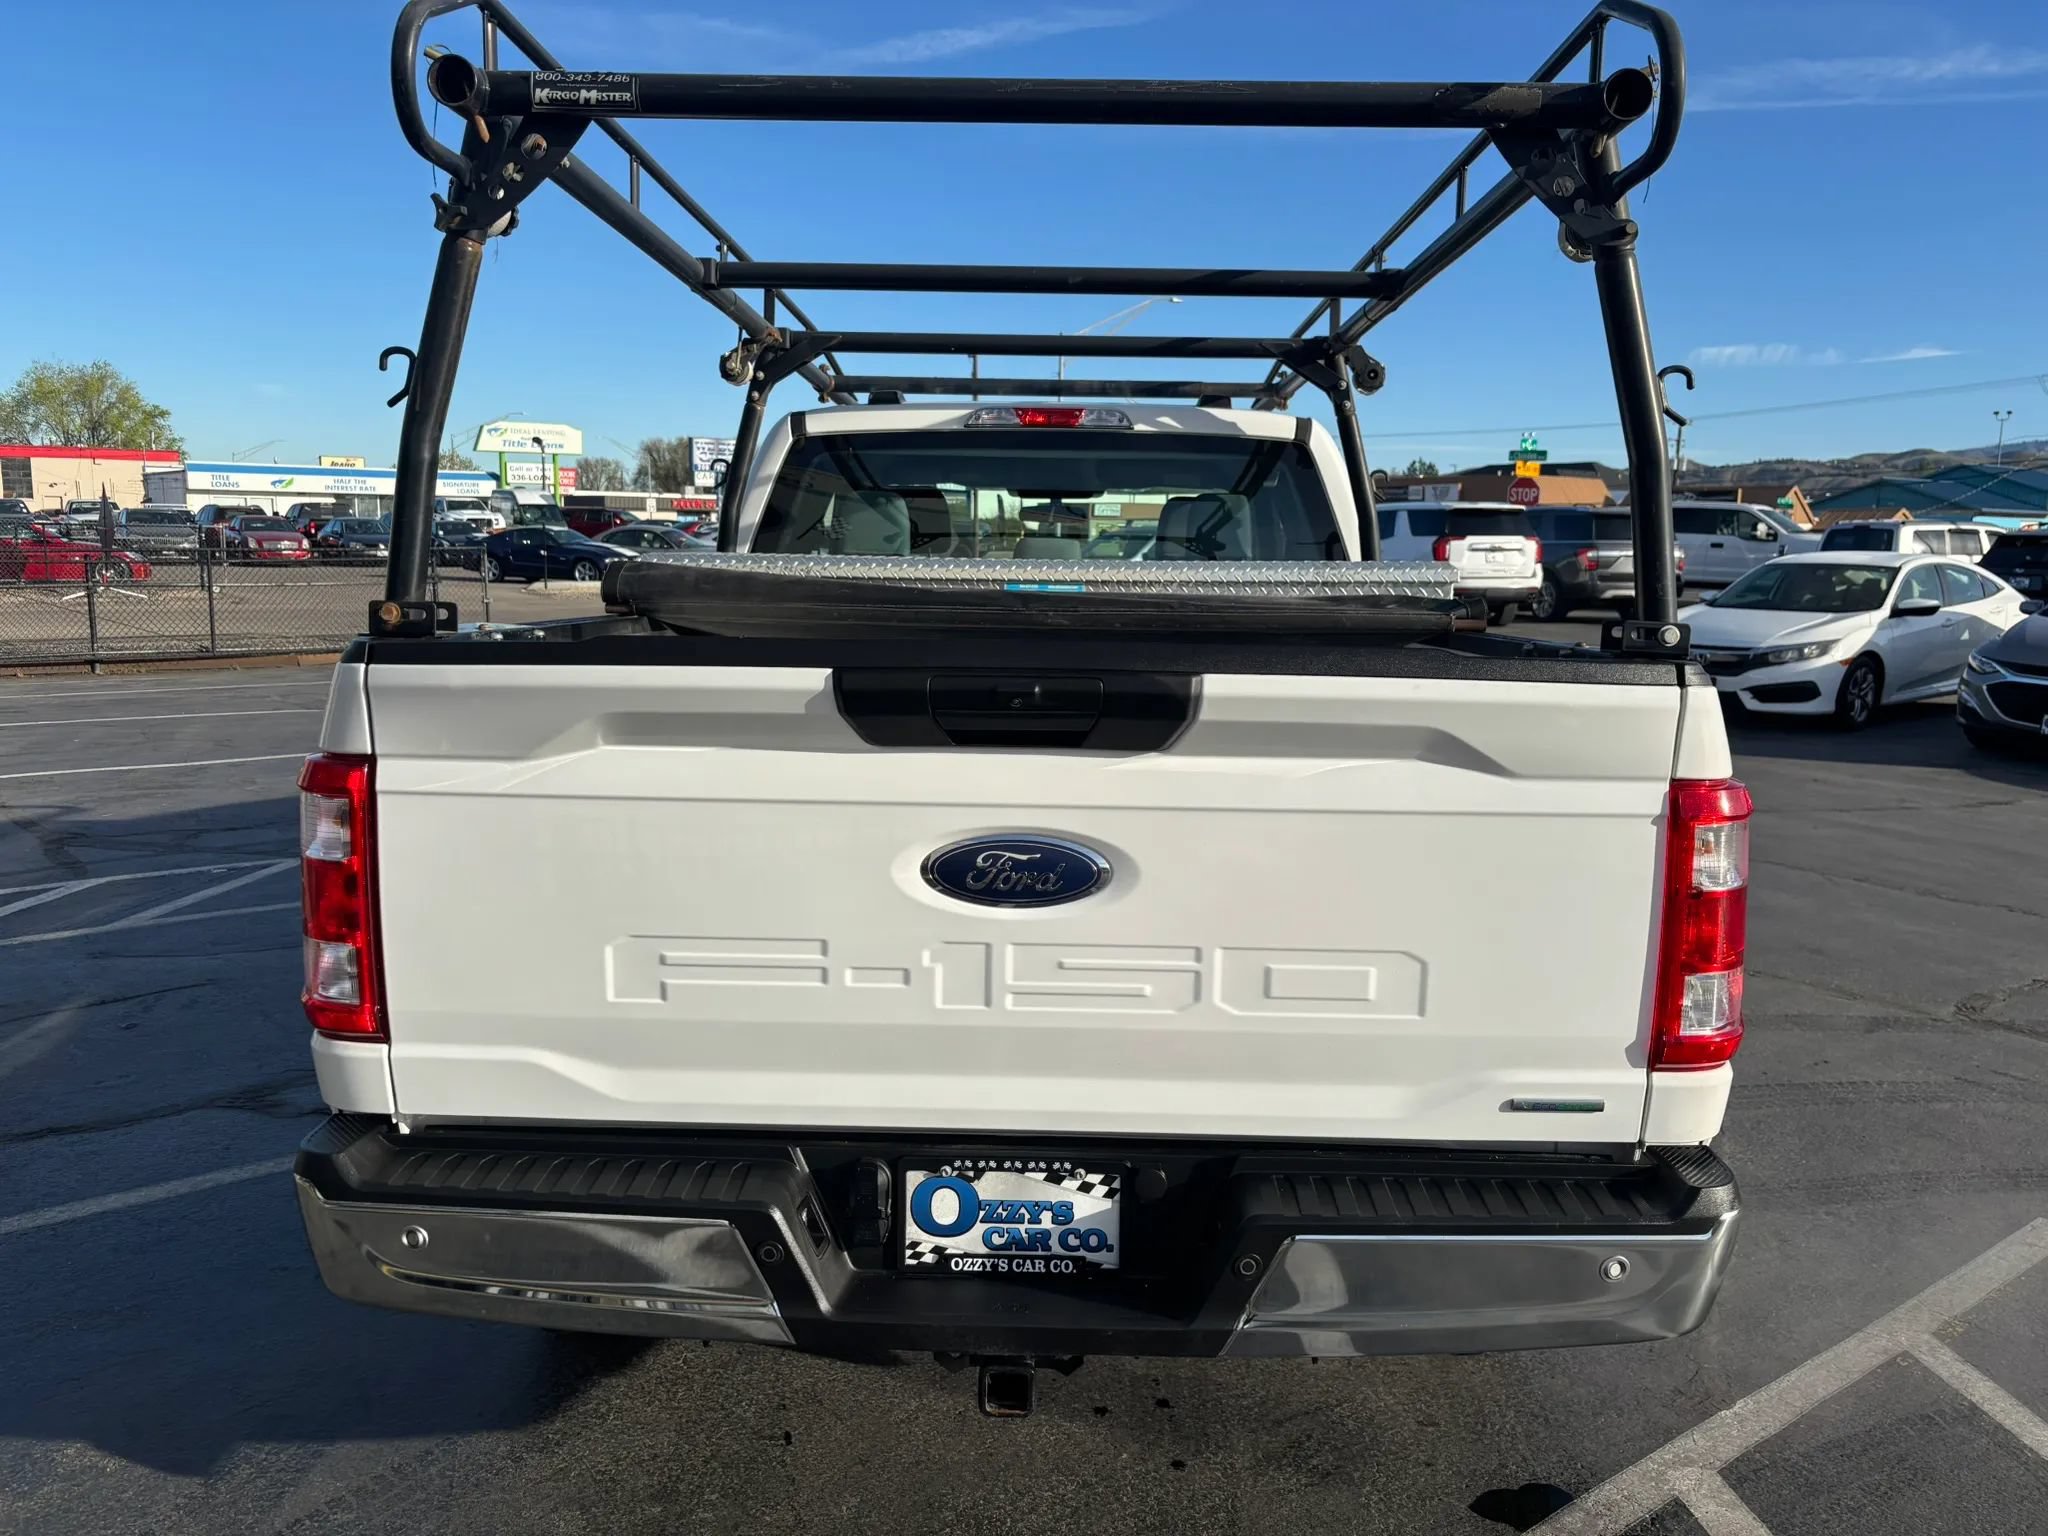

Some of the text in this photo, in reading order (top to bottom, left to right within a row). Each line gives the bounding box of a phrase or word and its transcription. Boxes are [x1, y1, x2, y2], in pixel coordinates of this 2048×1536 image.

[509, 427, 531, 435] IDEAL
[501, 439, 527, 449] Title
[211, 481, 240, 489] LOANS
[324, 484, 357, 492] INTEREST
[1509, 487, 1538, 502] STOP
[965, 850, 1066, 892] Ford
[604, 935, 1428, 1020] F-150
[910, 1175, 1075, 1238] OZZY'S
[982, 1226, 1115, 1253] CAR CO.
[950, 1257, 1077, 1274] OZZY'S CAR CO.
